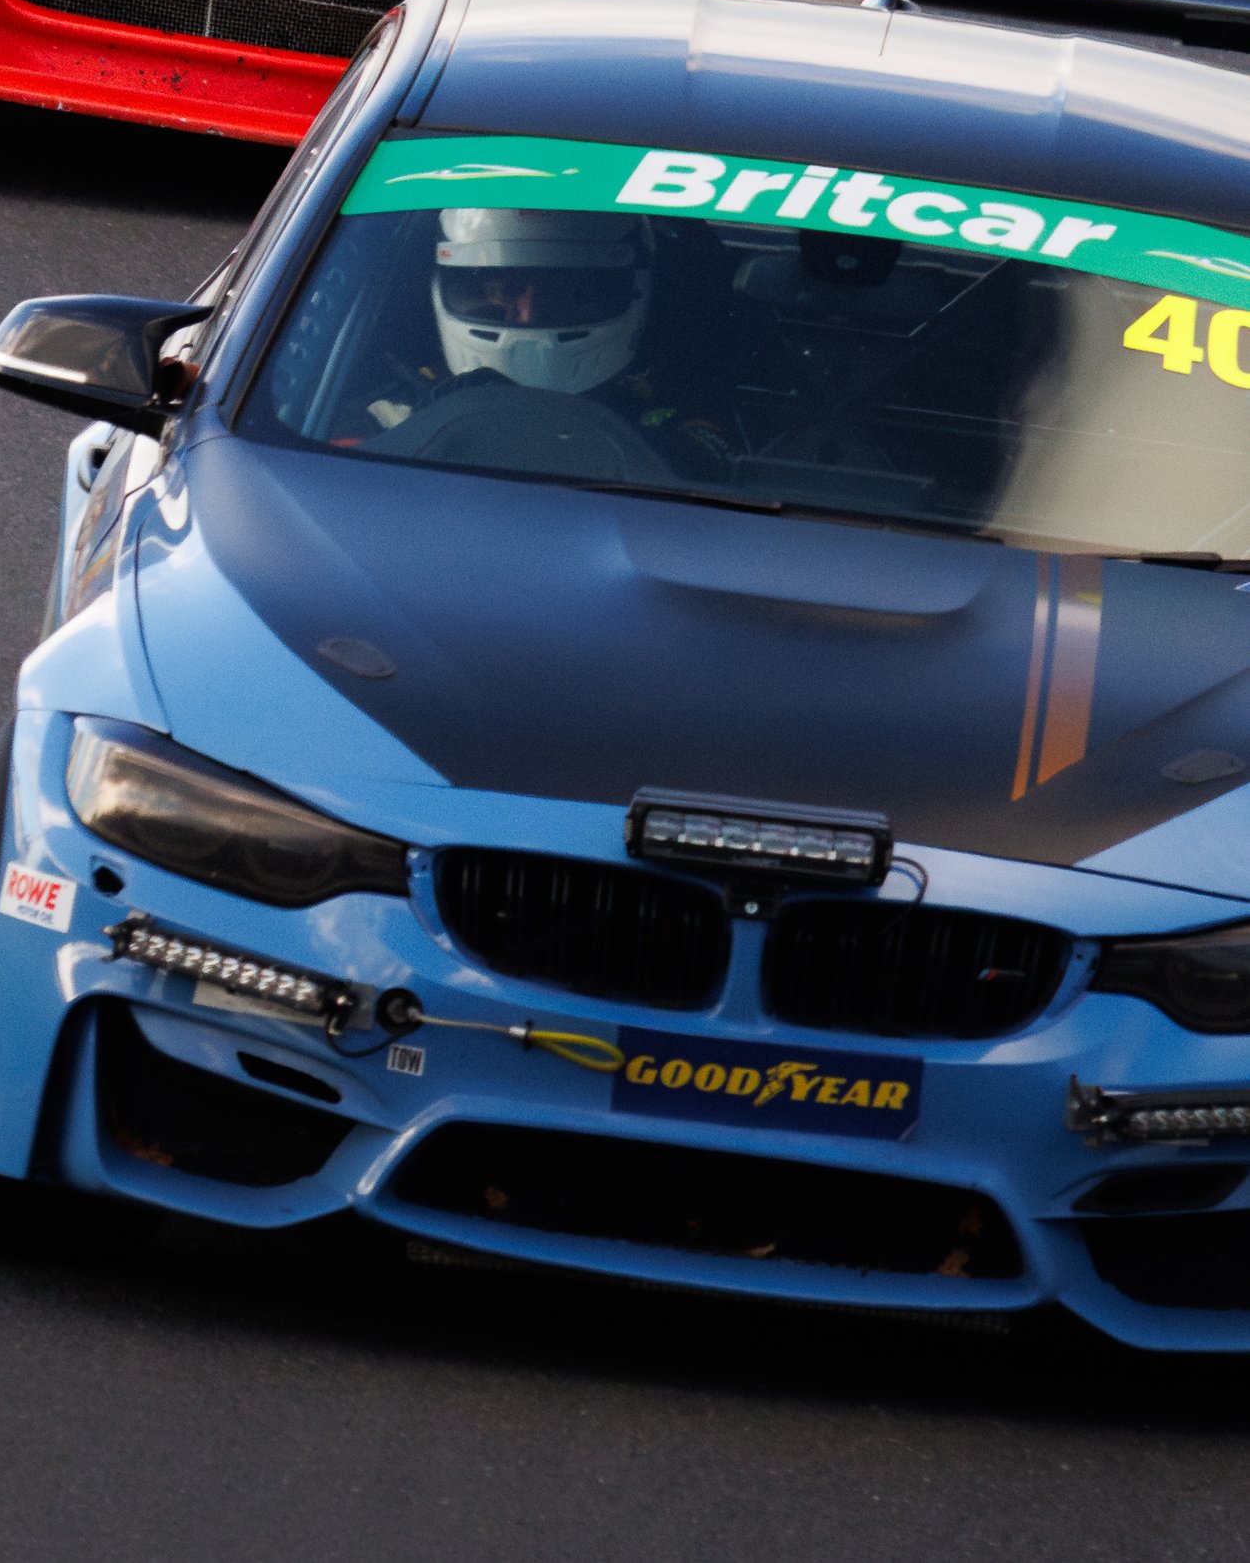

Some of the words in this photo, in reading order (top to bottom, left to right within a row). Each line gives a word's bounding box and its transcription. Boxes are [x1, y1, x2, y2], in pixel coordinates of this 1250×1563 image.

[615, 151, 1117, 258] Britcar
[7, 870, 61, 910] ROWE
[391, 1046, 422, 1073] TOW
